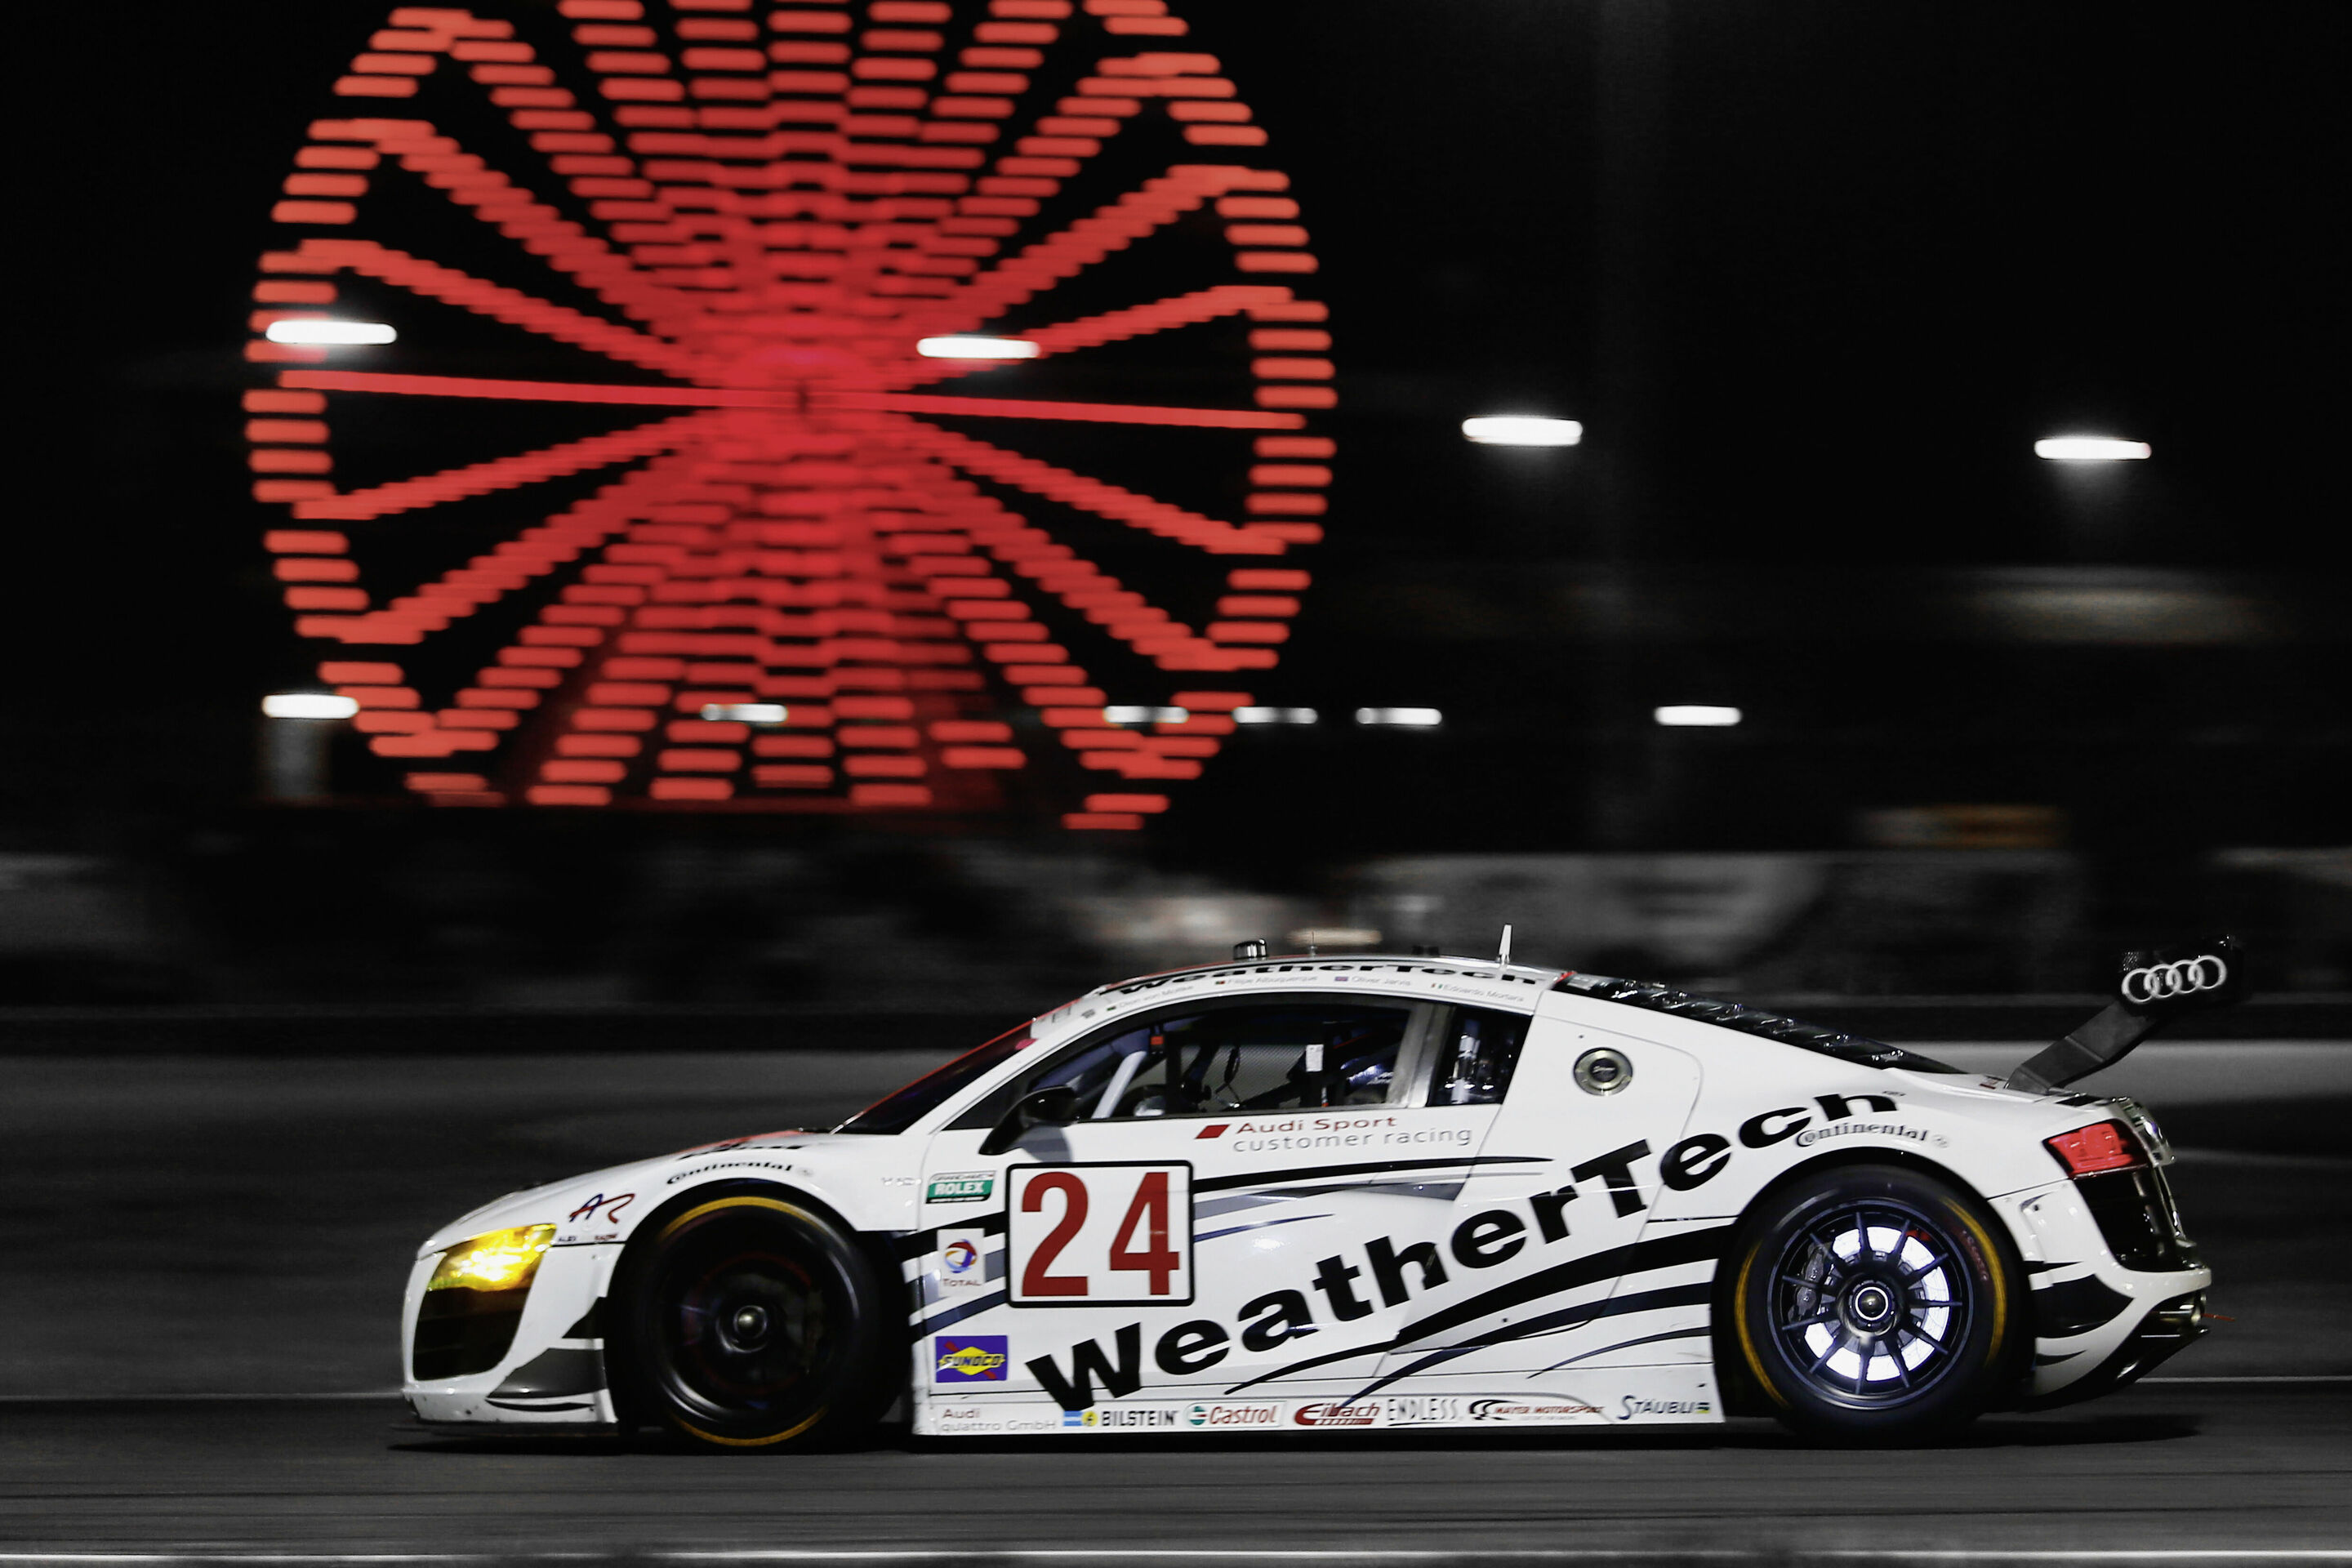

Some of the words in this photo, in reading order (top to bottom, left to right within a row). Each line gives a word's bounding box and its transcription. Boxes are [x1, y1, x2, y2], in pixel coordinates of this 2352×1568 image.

[1120, 964, 1540, 994] WeatherTech
[1236, 1119, 1303, 1134] Audi
[1312, 1116, 1398, 1133] Sport
[1795, 1122, 1928, 1147] Continental
[1233, 1132, 1371, 1152] customer
[1383, 1126, 1472, 1147] racing
[667, 1161, 793, 1184] Continental
[933, 1182, 986, 1196] ROLEX
[1021, 1171, 1179, 1297] 24
[1026, 1094, 1897, 1412] WeatherTech
[942, 1277, 982, 1287] TOTAL
[942, 1353, 1002, 1369] SUNOCO
[942, 1408, 979, 1419] Audi
[1102, 1410, 1177, 1427] BILSTEIN
[1209, 1405, 1277, 1425] Castrol
[1294, 1401, 1380, 1426] Eibach
[1388, 1397, 1458, 1421] ENDLESS
[941, 1419, 1000, 1433] quattro
[1006, 1419, 1056, 1432] GmbH
